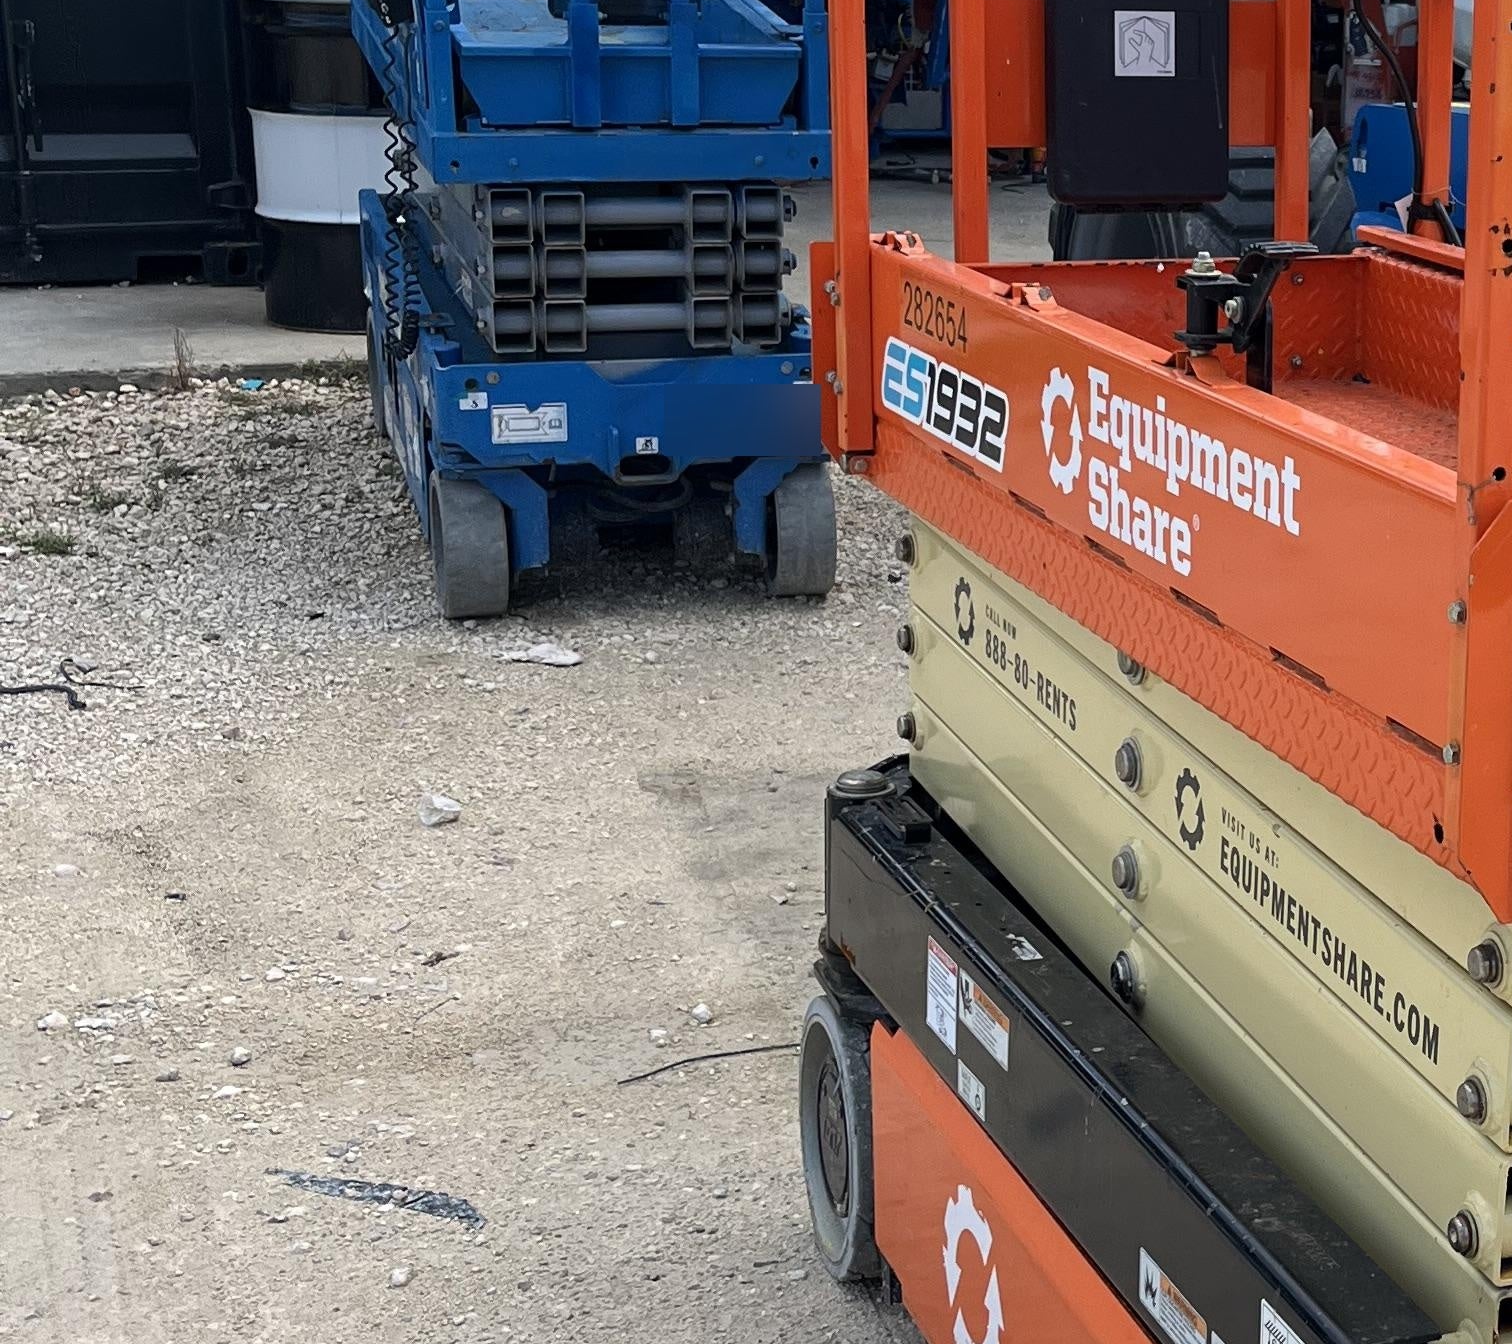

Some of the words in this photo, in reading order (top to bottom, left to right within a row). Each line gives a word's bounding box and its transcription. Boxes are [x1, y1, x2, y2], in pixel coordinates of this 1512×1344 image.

[903, 280, 968, 353] 282654
[883, 338, 1008, 467] ES1932
[1088, 365, 1302, 536] Equipment
[1088, 457, 1192, 577] Share
[985, 604, 1000, 628] CALL
[1003, 619, 1017, 640] NOW
[985, 628, 1077, 731] 888-80-RENTS
[1221, 807, 1247, 841] VISIT
[1250, 830, 1263, 851] US
[1265, 845, 1280, 869] AT:
[1220, 838, 1440, 1065] EQUIPMENTSHARE.COM
